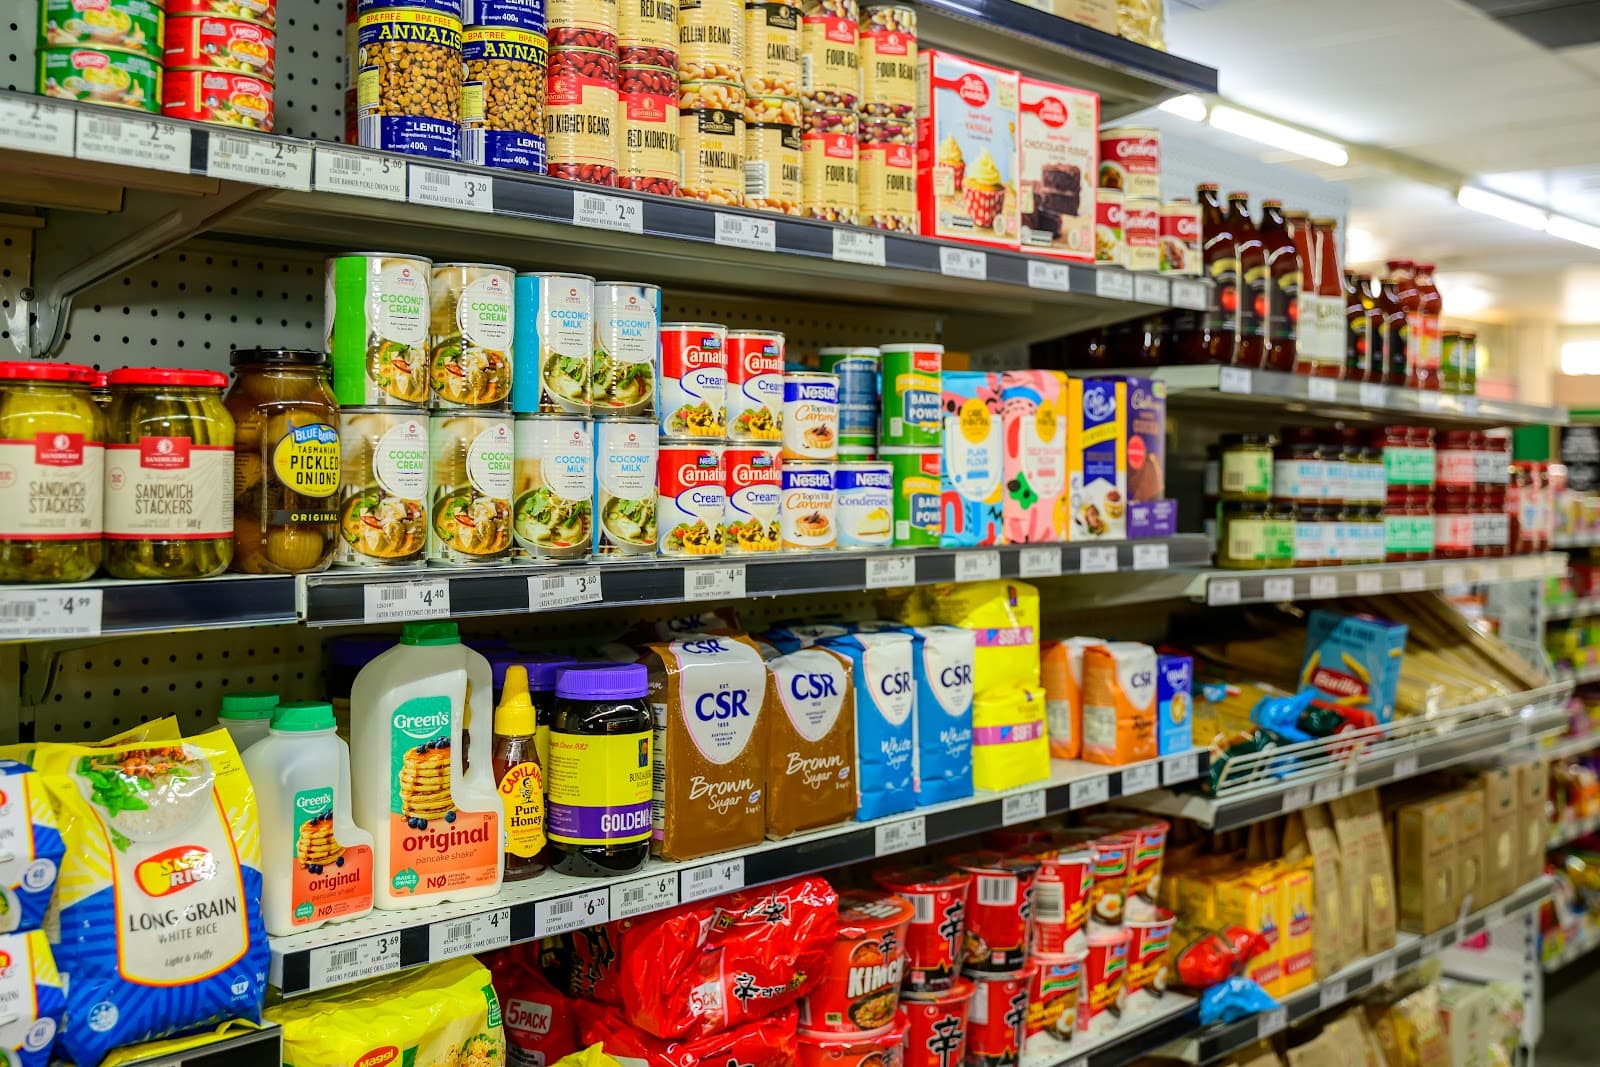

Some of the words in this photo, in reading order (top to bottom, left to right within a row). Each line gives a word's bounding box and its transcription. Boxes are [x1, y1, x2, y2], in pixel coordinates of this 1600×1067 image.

[366, 14, 379, 23] BPA
[380, 12, 401, 21] FREE
[415, 13, 432, 23] BPA
[433, 16, 451, 27] FREE
[502, 13, 518, 23] 400g
[467, 32, 483, 40] BPA
[484, 31, 506, 40] FREE
[518, 34, 531, 43] BPA
[708, 26, 731, 45] BEANS
[826, 49, 844, 66] FOUR
[876, 61, 897, 78] FOUR
[413, 122, 451, 136] LENTILS
[556, 115, 585, 133] KIDNEY
[587, 116, 610, 137] BEANS
[410, 141, 427, 151] 400g
[627, 130, 642, 147] RED
[644, 130, 668, 149] KIDNEY
[514, 155, 529, 166] 400g
[826, 165, 844, 182] FOUR
[464, 180, 487, 198] $3.20
[886, 174, 904, 191] FOUR
[615, 203, 635, 220] $2.00
[751, 224, 769, 239] $2.00
[380, 294, 424, 306] COCONUT
[388, 304, 420, 315] CREAM
[479, 312, 507, 322] CREAM
[550, 310, 590, 321] COCONUT
[562, 319, 583, 329] MILK
[609, 319, 650, 328] COCONUT
[621, 327, 642, 337] MILK
[294, 427, 319, 441] BLUE
[290, 455, 338, 470] PICKLED
[396, 460, 424, 470] CREAM
[487, 461, 511, 471] CREAM
[609, 455, 650, 464] COCONUT
[620, 463, 641, 472] MILK
[566, 464, 585, 473] MILK
[296, 472, 336, 485] ONIONS
[789, 474, 830, 487] Nestlé
[29, 481, 86, 497] SANDWICH
[135, 483, 193, 499] SANDWICH
[28, 499, 86, 514] STACKERS
[135, 499, 193, 514] STACKERS
[786, 493, 832, 510] Caramel
[290, 513, 338, 522] ORIGINAL
[419, 589, 444, 606] $4.40
[682, 639, 729, 654] CSR
[881, 671, 911, 696] CSR
[941, 664, 972, 688] CSR
[791, 673, 838, 700] CSR
[695, 689, 750, 721] CSR
[393, 711, 450, 729] Green's
[939, 727, 971, 743] White
[881, 736, 912, 753] White
[785, 752, 844, 775] Brown
[887, 754, 907, 770] Sugar
[689, 776, 753, 800] Brown
[802, 771, 832, 790] Sugar
[296, 793, 331, 809] Green's
[708, 794, 742, 815] Sugar
[515, 804, 540, 816] Pure
[511, 814, 542, 828] Honey
[601, 810, 647, 833] GOLDEN
[402, 821, 489, 853] original
[415, 850, 449, 866] pancake
[309, 867, 360, 891] original
[721, 864, 740, 880] $4.90
[657, 877, 675, 893] $6.99
[129, 909, 178, 932] LONG
[185, 896, 238, 922] GRAIN
[583, 897, 605, 915] $6.20
[487, 911, 509, 928] $4.20
[158, 930, 193, 944] WHITE
[195, 922, 218, 936] RICE
[377, 936, 399, 954] $3.69
[359, 1049, 394, 1067] Maggi
